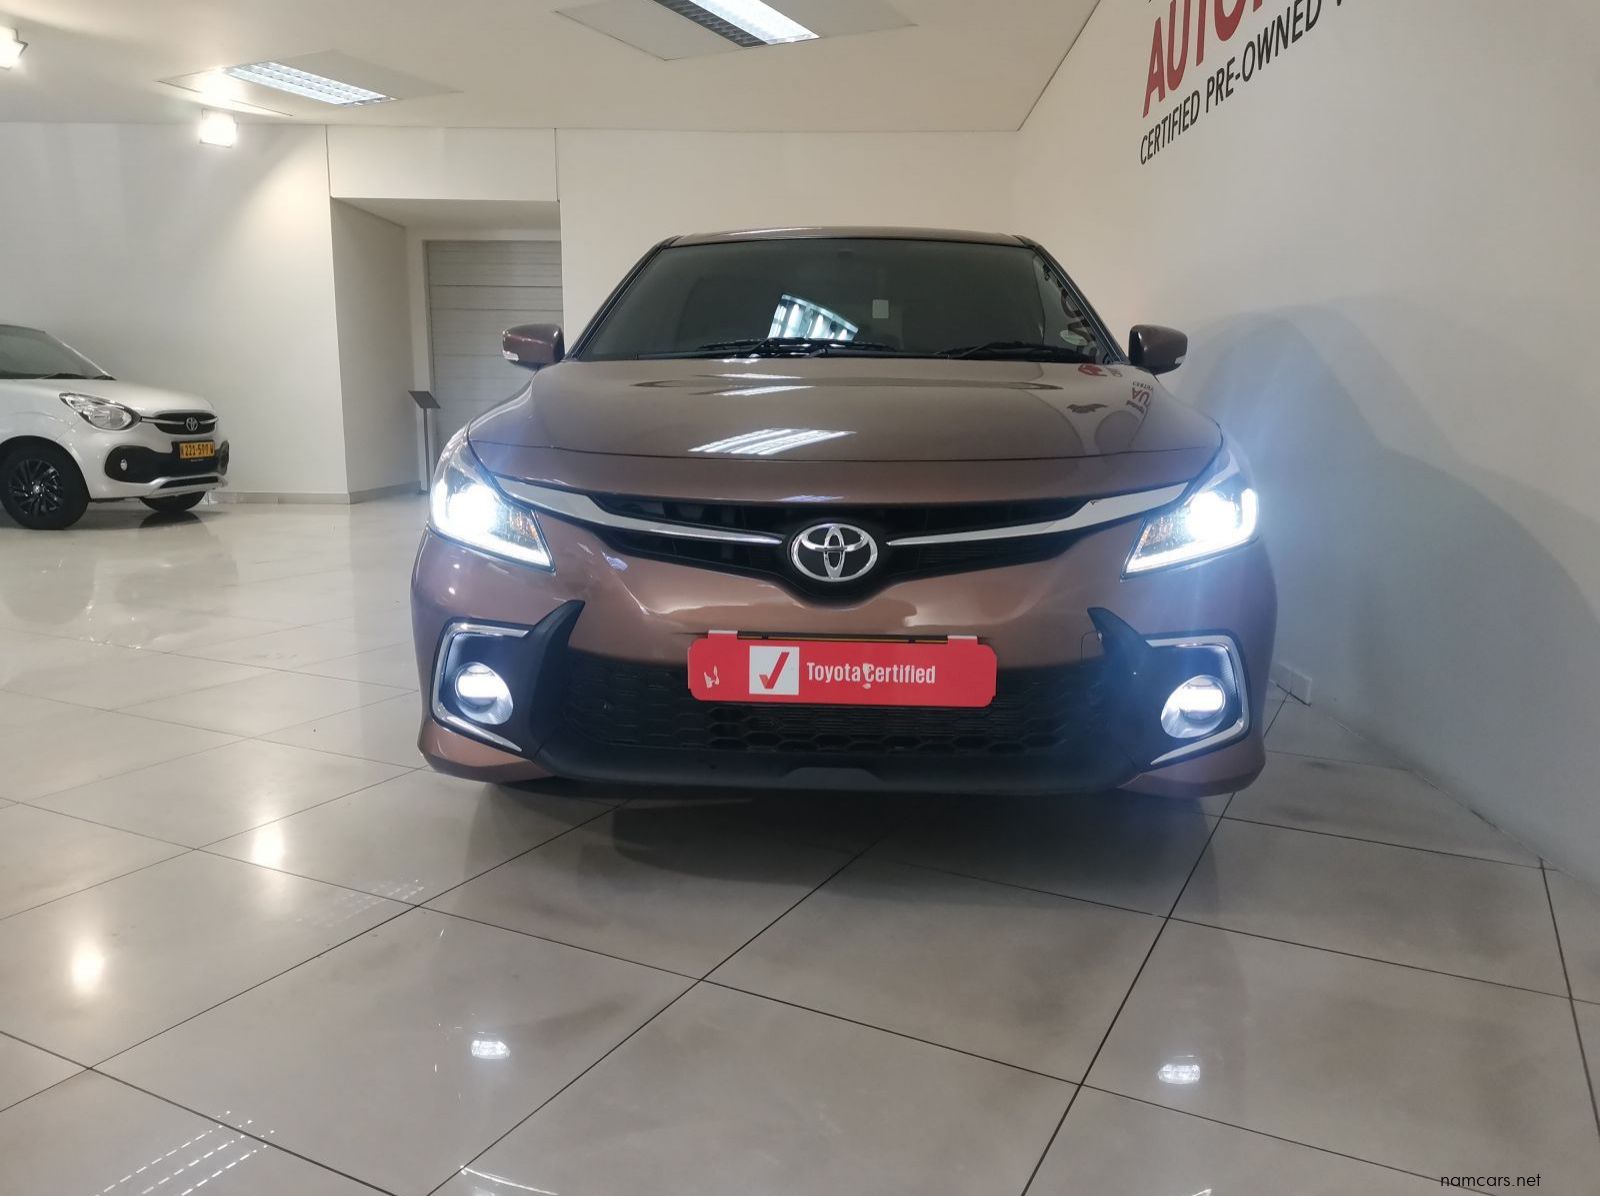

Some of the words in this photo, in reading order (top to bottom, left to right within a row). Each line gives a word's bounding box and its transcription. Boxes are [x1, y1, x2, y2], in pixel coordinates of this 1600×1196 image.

[1140, 90, 1200, 165] CERTIFIED
[1206, 0, 1321, 113] PRE-OWNED
[806, 662, 861, 683] Toyota
[862, 663, 936, 685] Certified
